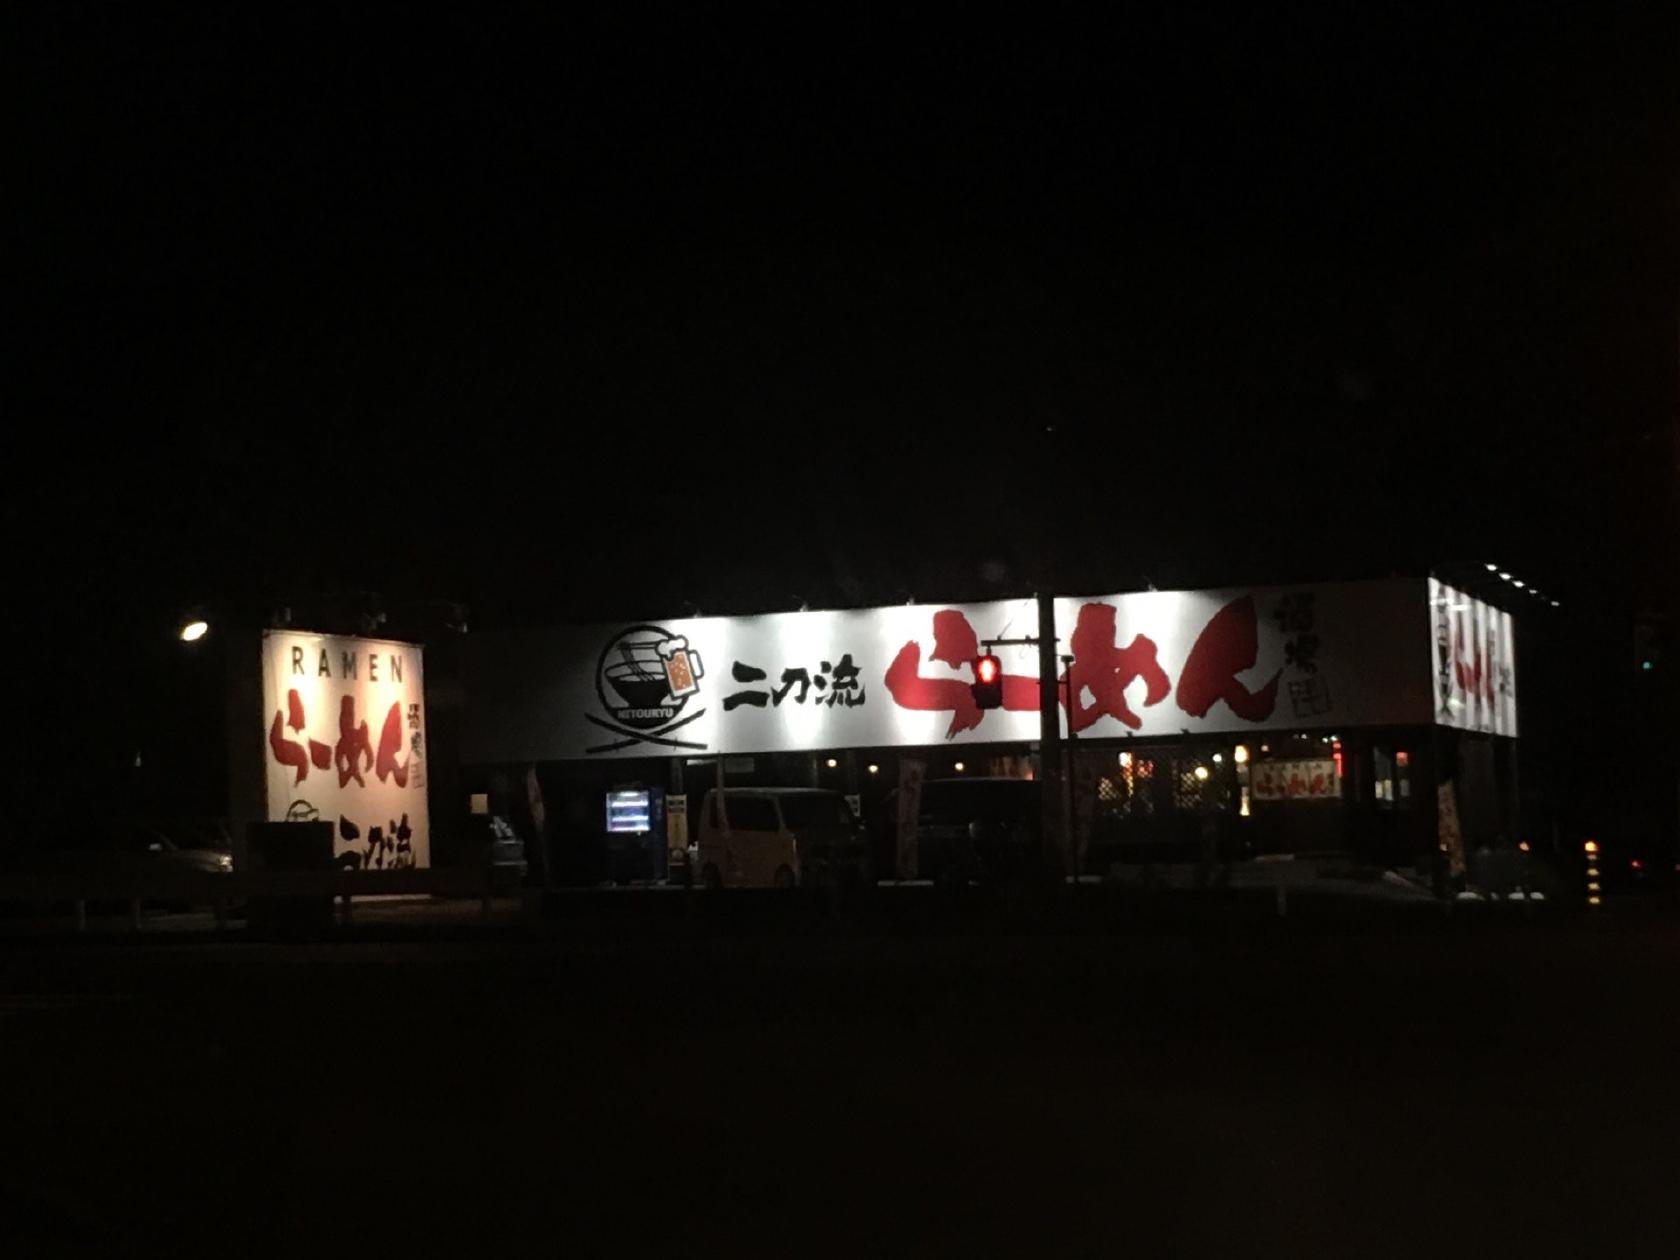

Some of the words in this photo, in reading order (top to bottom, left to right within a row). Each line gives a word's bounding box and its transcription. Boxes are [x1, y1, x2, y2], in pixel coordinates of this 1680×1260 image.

[292, 646, 404, 683] RAMEN
[723, 653, 866, 711] 二刀流
[270, 688, 410, 789] らーめん
